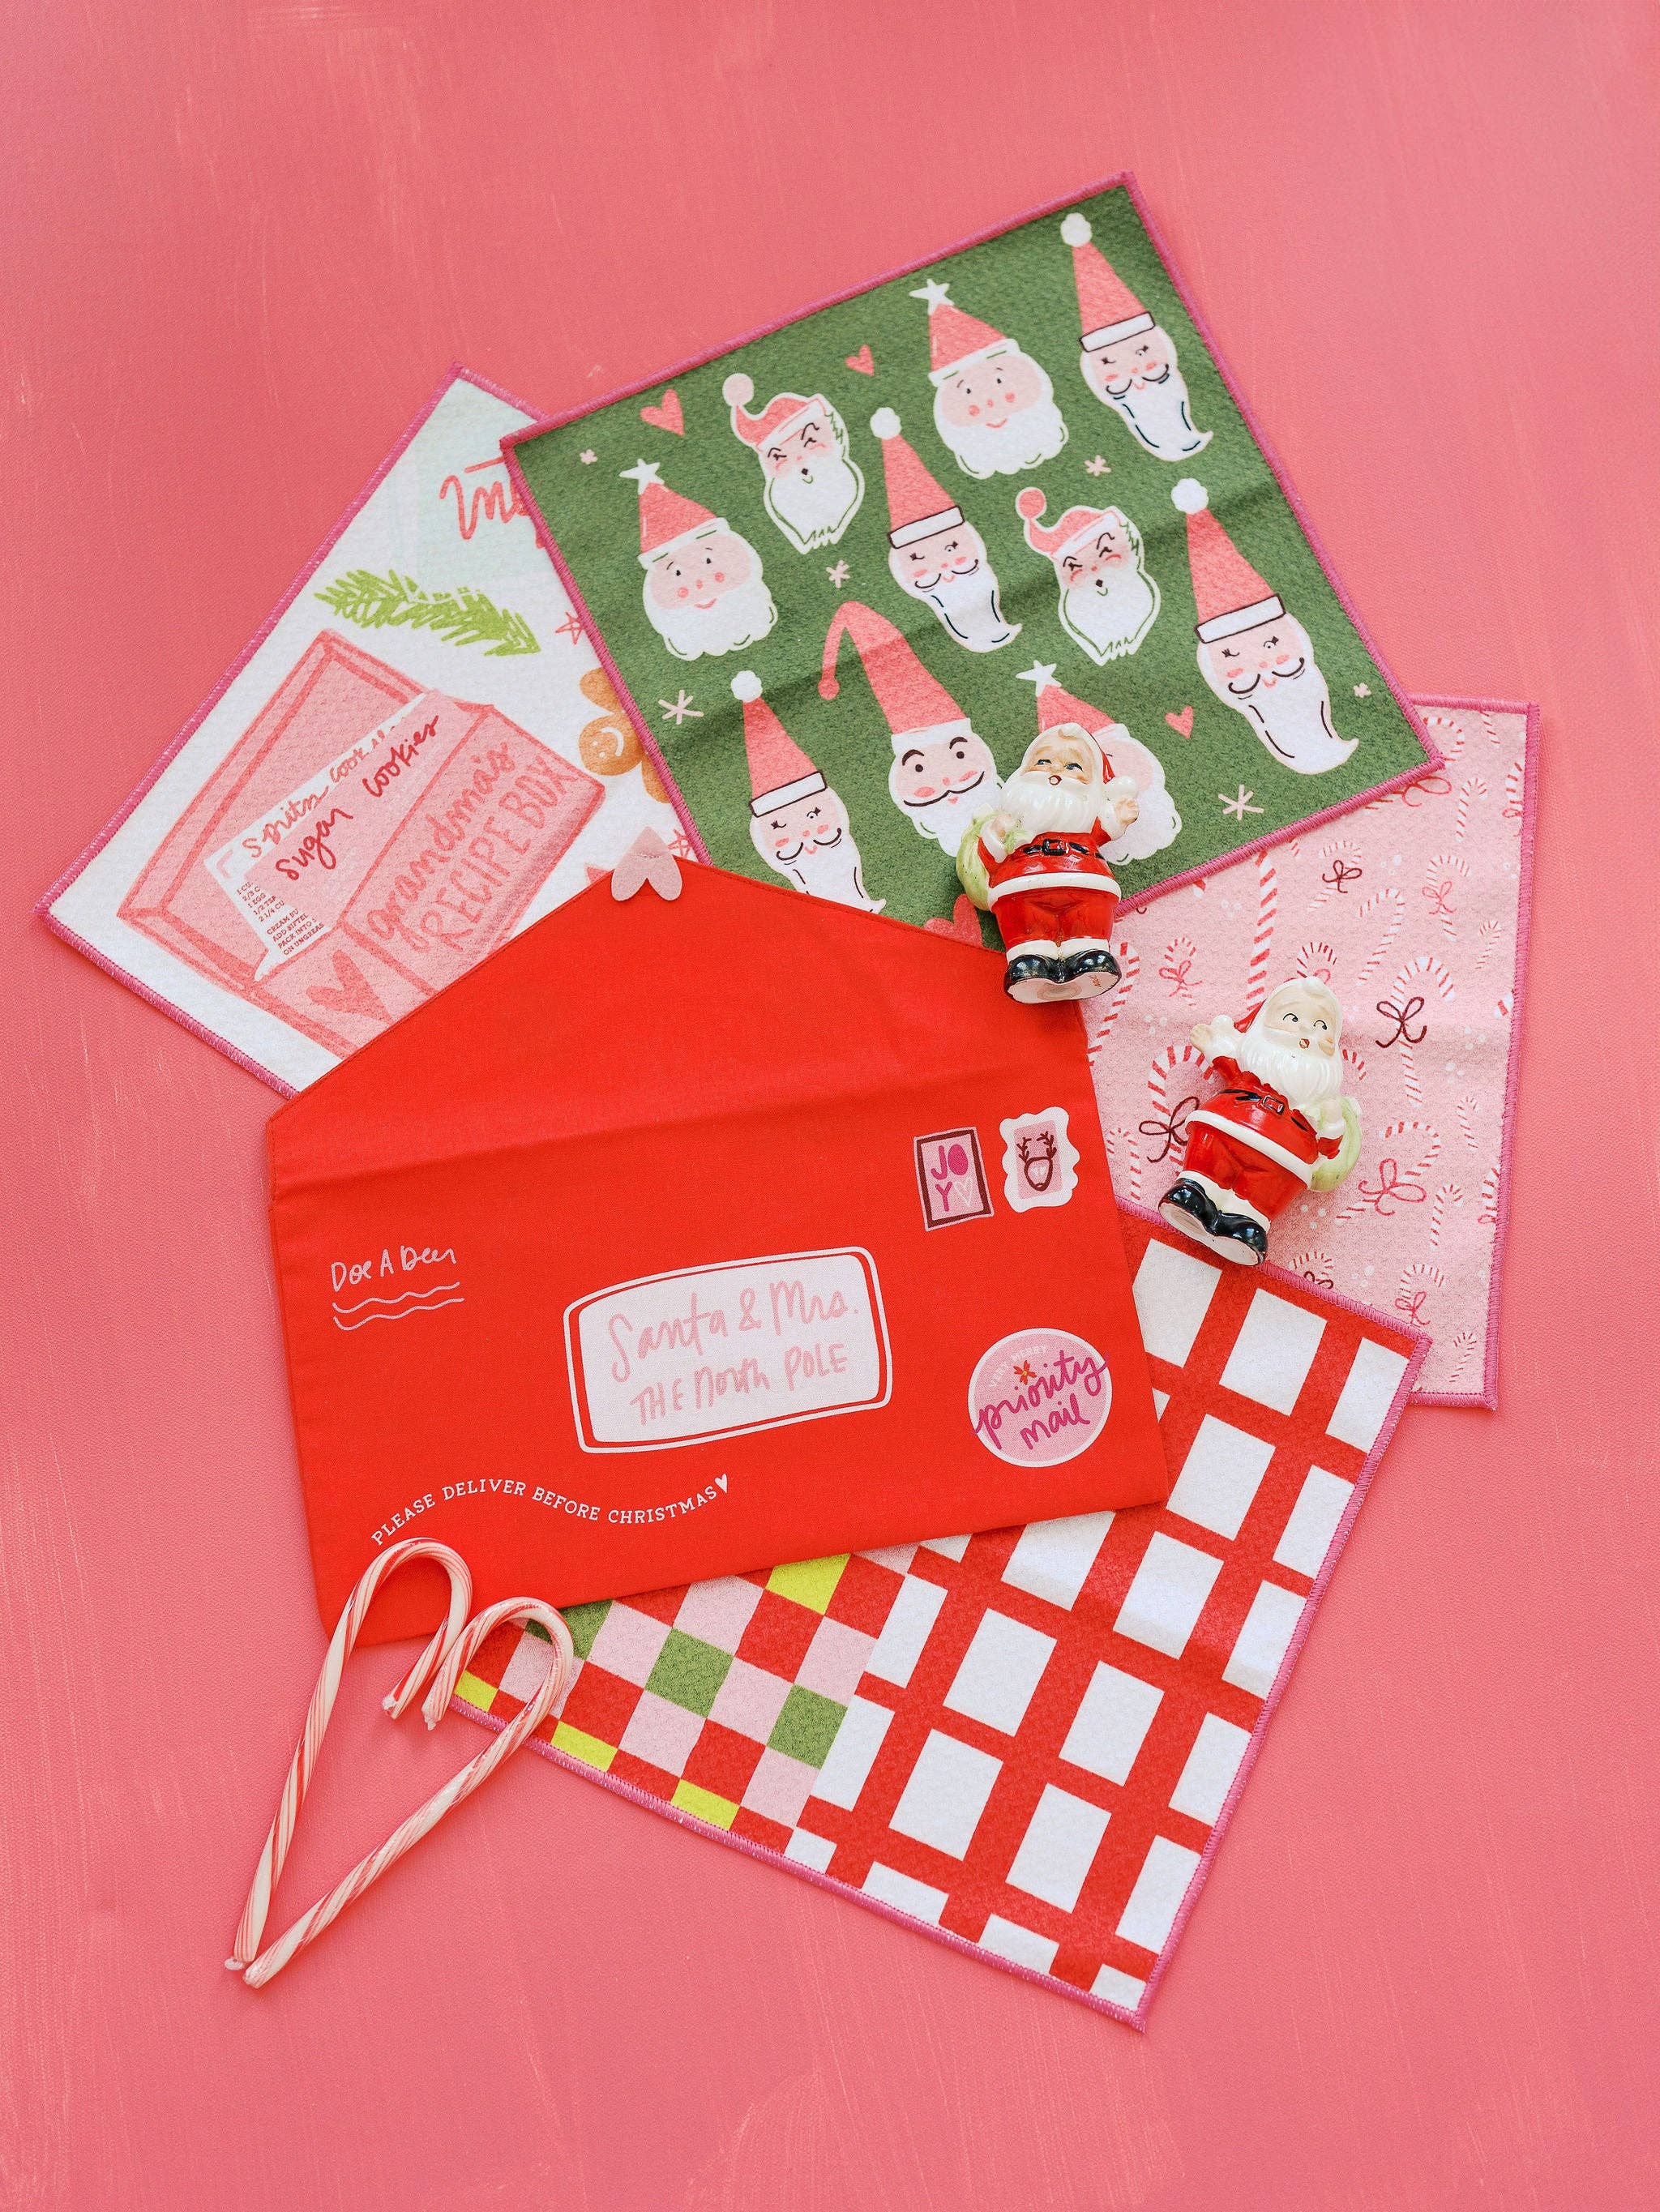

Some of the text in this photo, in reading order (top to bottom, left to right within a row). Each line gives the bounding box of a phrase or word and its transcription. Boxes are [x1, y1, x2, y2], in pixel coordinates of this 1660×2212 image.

[420, 755, 578, 952] RECIPE BOX
[242, 891, 254, 901] 2/3
[253, 892, 266, 905] EGG
[254, 905, 265, 915] 1/2
[263, 909, 276, 918] 1/4
[267, 917, 290, 935] CREAM
[272, 929, 287, 942] ADD
[278, 922, 312, 949] PACK INTO
[283, 945, 294, 956] ON
[380, 1248, 394, 1277] A
[608, 1292, 729, 1383] Santa
[738, 1288, 762, 1332] &
[630, 1378, 682, 1427] THE
[784, 1342, 848, 1392] POLE
[973, 1350, 1110, 1450] priority
[1020, 1393, 1090, 1450] mail
[370, 1478, 718, 1546] PLEASE DELIVER BEFORE CHRISTMAS
